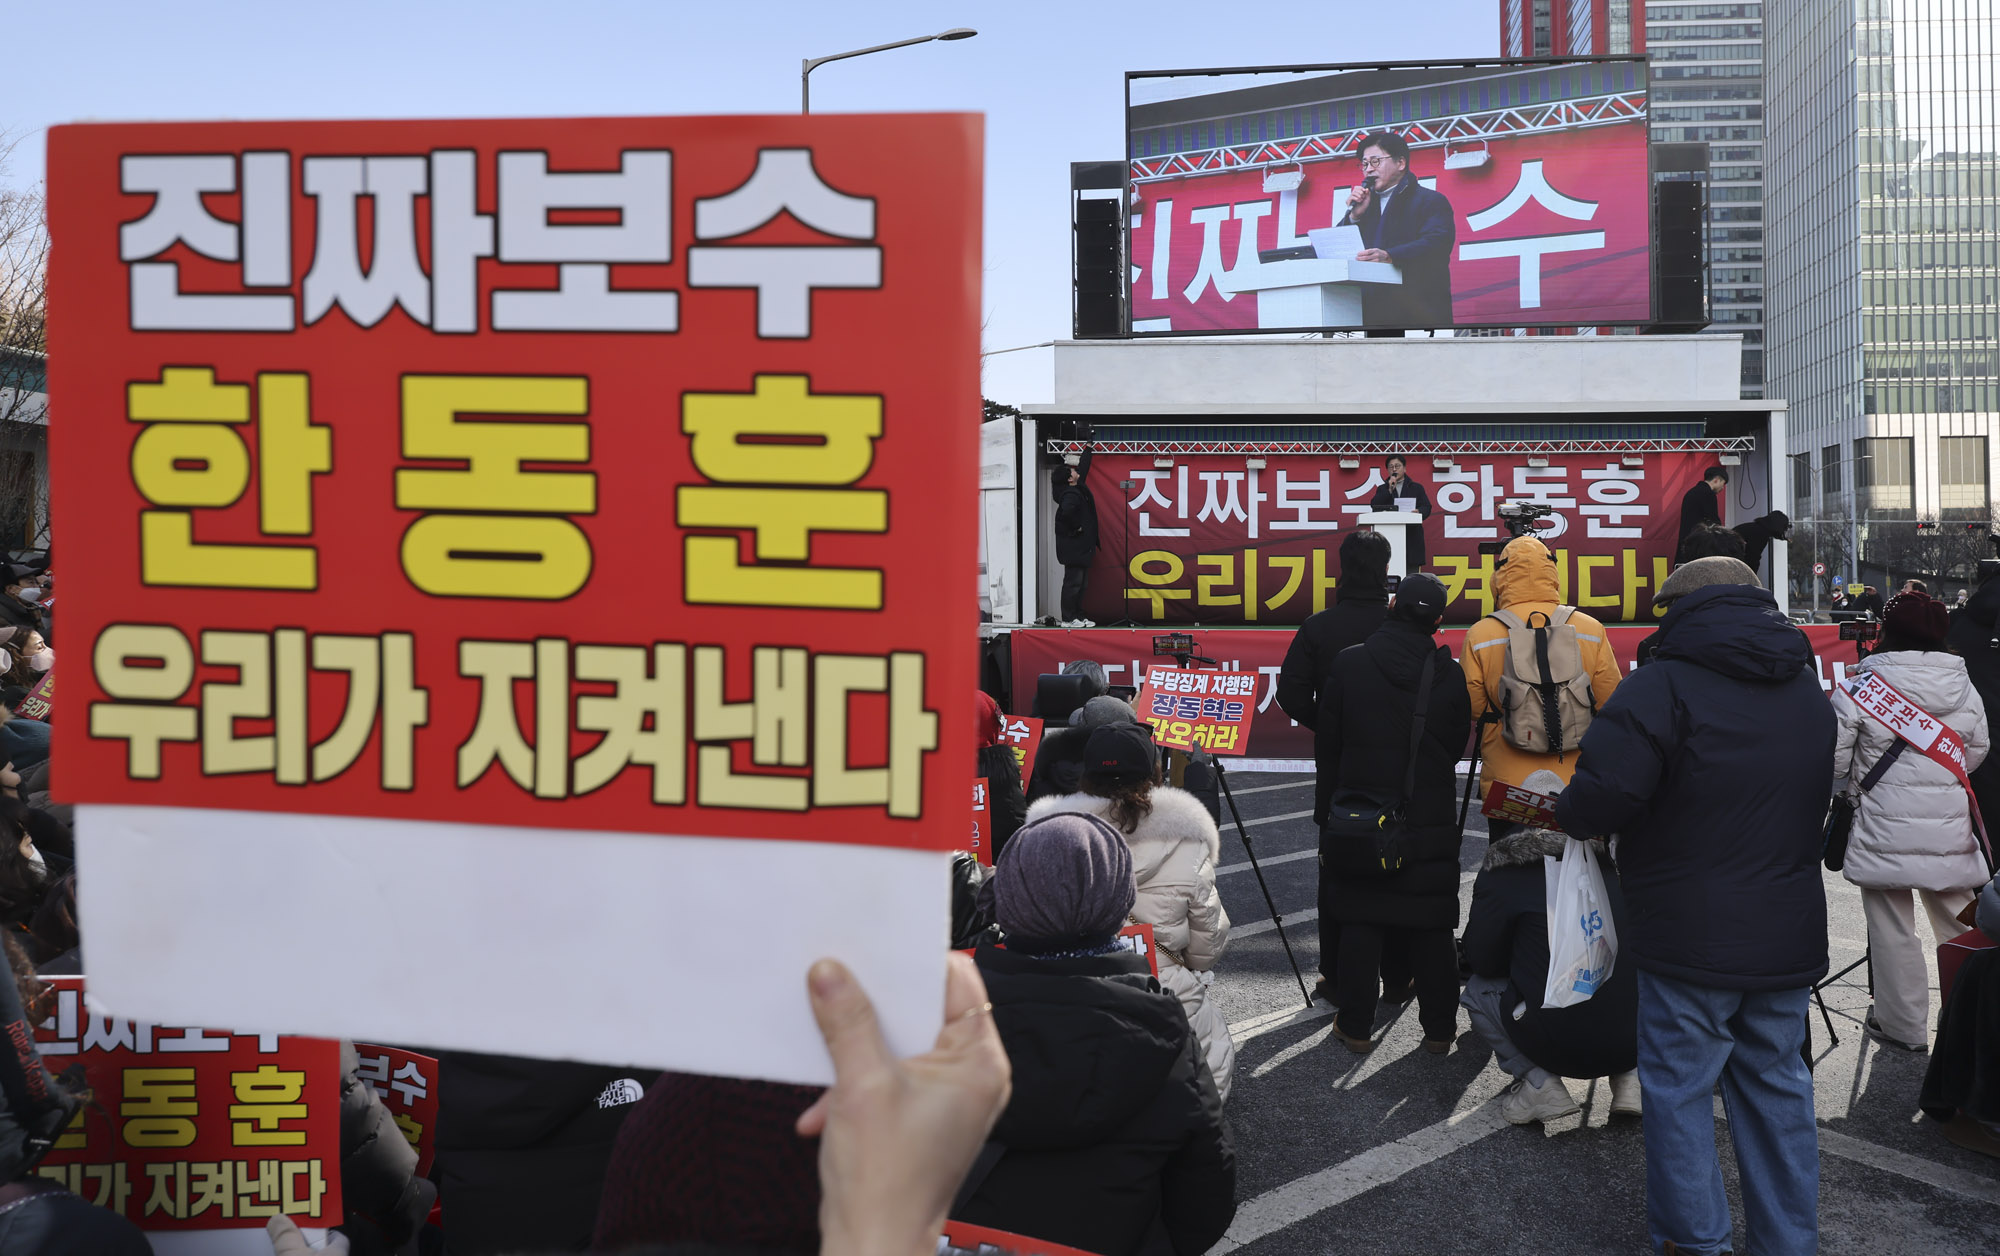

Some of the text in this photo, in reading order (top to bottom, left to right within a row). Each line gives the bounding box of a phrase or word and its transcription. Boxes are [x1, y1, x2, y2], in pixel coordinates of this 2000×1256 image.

[119, 147, 885, 339] 진짜보수
[1124, 547, 1336, 621] 우리가
[1149, 670, 1209, 694] 부당징계
[1210, 675, 1255, 696] 자행한
[1152, 693, 1244, 721] 장동혁은
[1858, 690, 1911, 730] 우리가
[1866, 678, 1935, 732] 진짜보수
[88, 622, 938, 820] 우리가 지켜낸다
[1146, 717, 1239, 750] 각오하라
[144, 1158, 326, 1219] 지켜낸다
